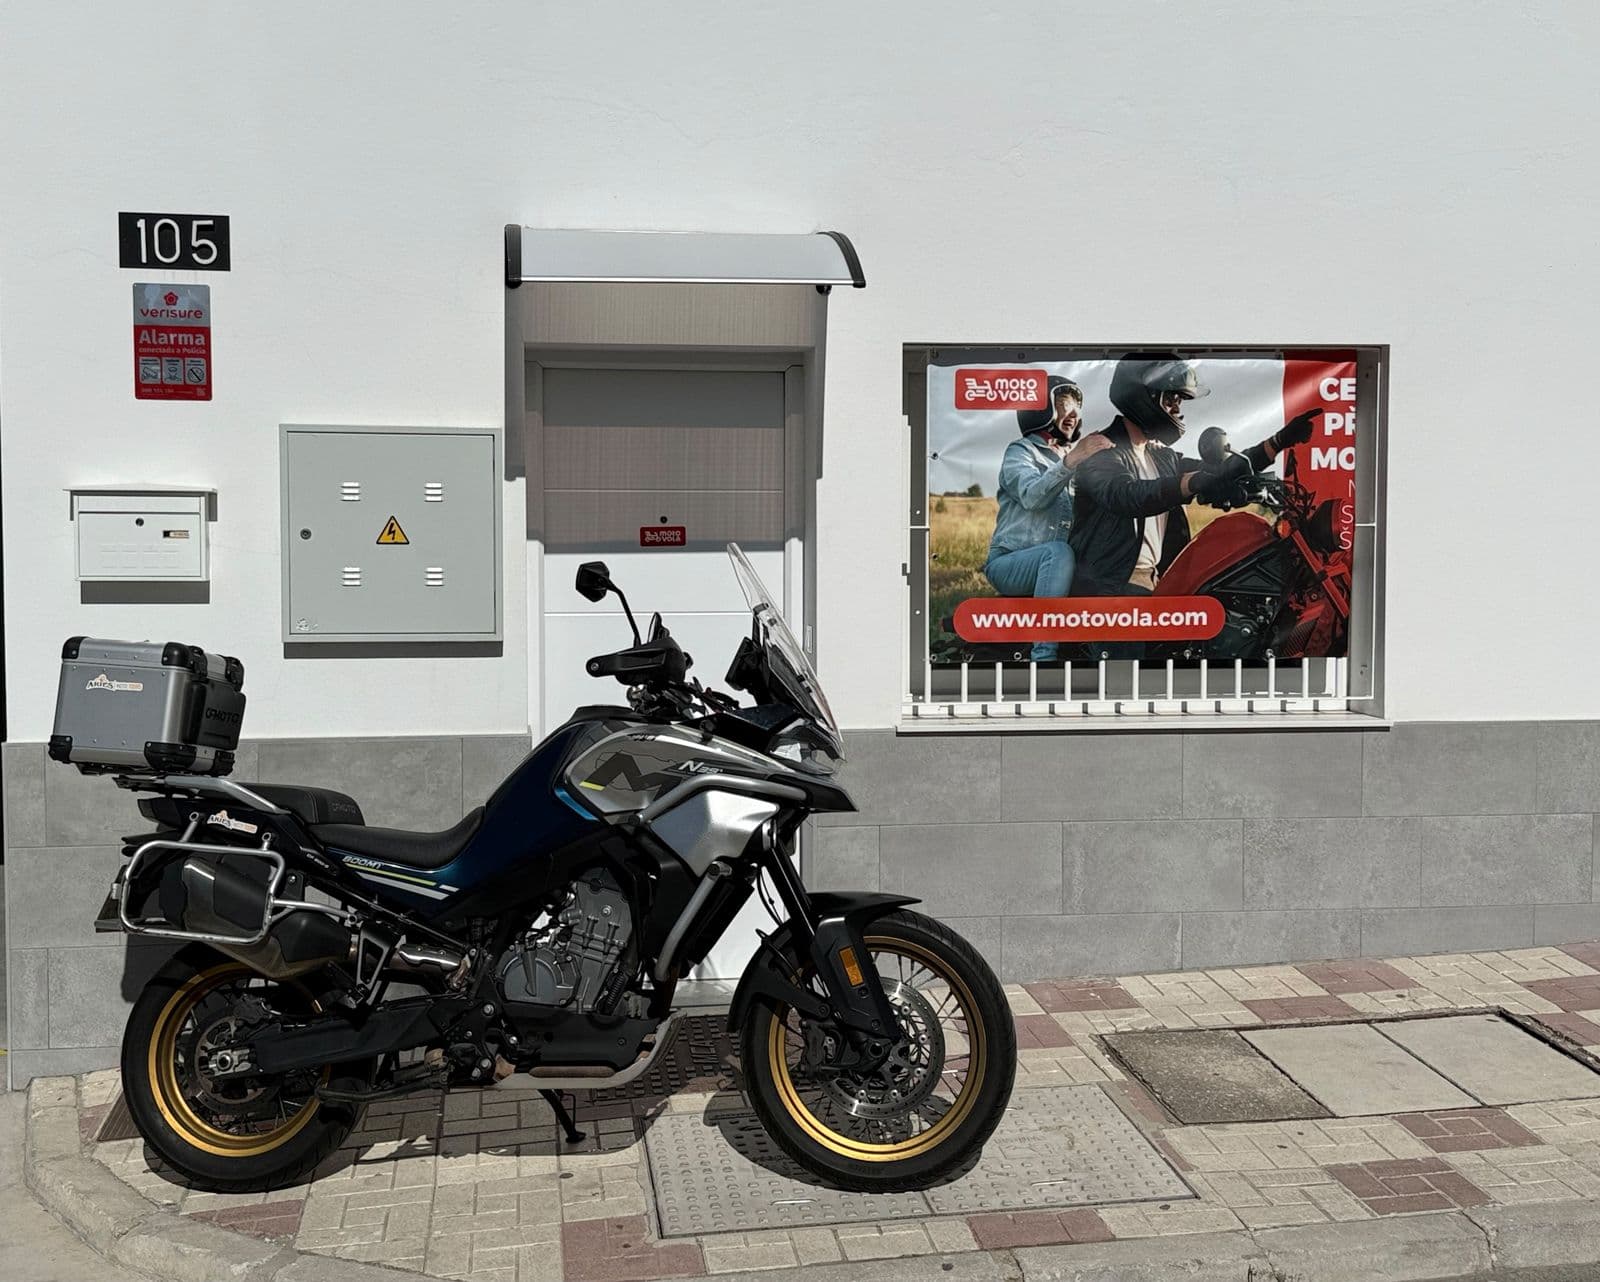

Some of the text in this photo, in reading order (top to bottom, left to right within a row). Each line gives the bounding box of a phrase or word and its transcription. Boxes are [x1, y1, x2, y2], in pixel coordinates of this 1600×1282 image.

[137, 218, 218, 265] 105
[140, 308, 203, 319] verisure
[139, 329, 206, 346] Alarma
[1319, 377, 1357, 402] CE
[1310, 446, 1356, 471] MO
[972, 608, 1208, 629] www.motovola.com
